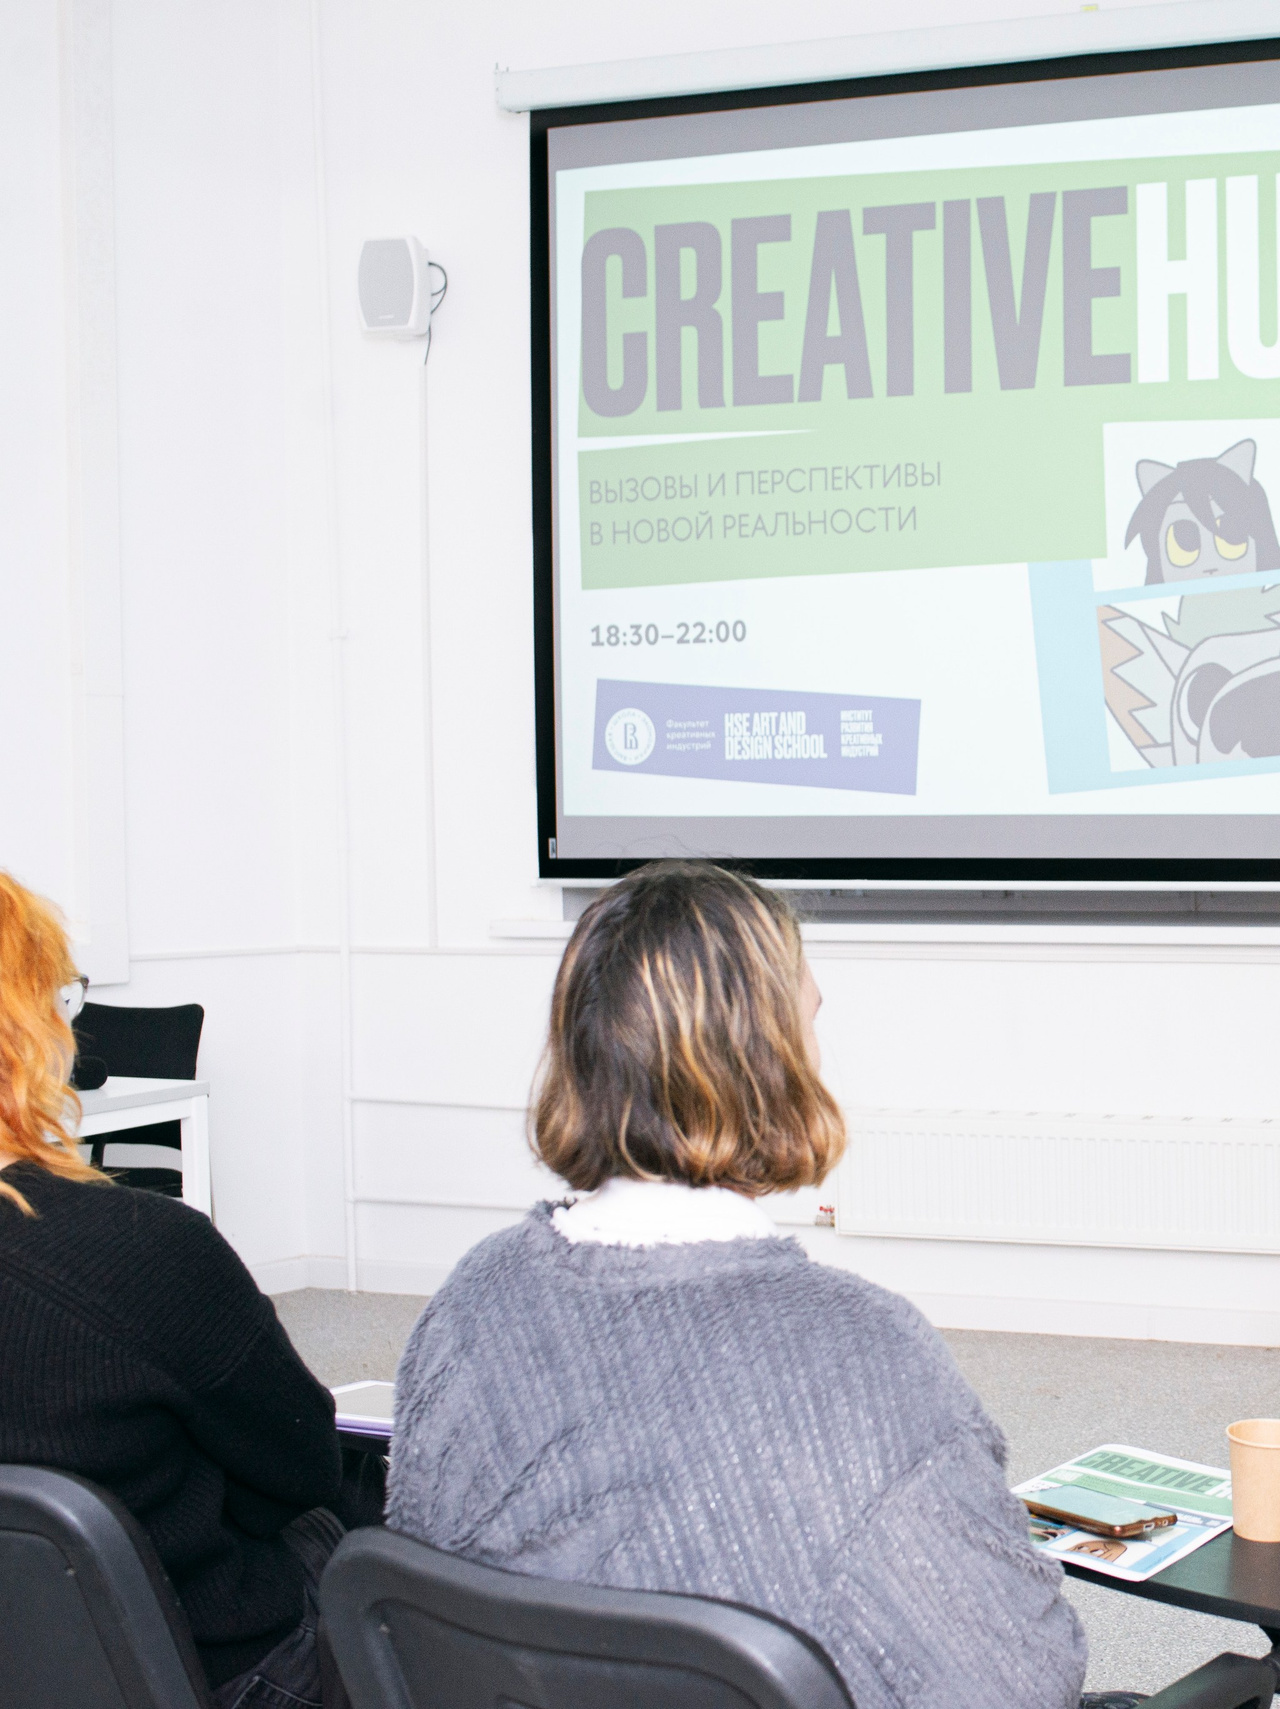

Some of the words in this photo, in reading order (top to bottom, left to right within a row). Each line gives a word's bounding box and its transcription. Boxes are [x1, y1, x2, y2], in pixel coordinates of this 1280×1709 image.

[589, 474, 697, 504] ВЫЗОВЫ
[708, 471, 726, 497] И
[735, 461, 942, 496] ПЕРСПЕКТИВЫ
[590, 520, 604, 546] В
[611, 510, 713, 546] НОВОЙ
[723, 505, 918, 539] РЕАЛЬНОСТИ
[666, 719, 710, 730] Факультет
[724, 712, 750, 737] HSE
[752, 711, 778, 736] ART
[778, 710, 806, 735] AND
[724, 735, 773, 760] DESIGN
[774, 733, 828, 760] SCHOOL
[1074, 1451, 1232, 1500] CREATIVEH
